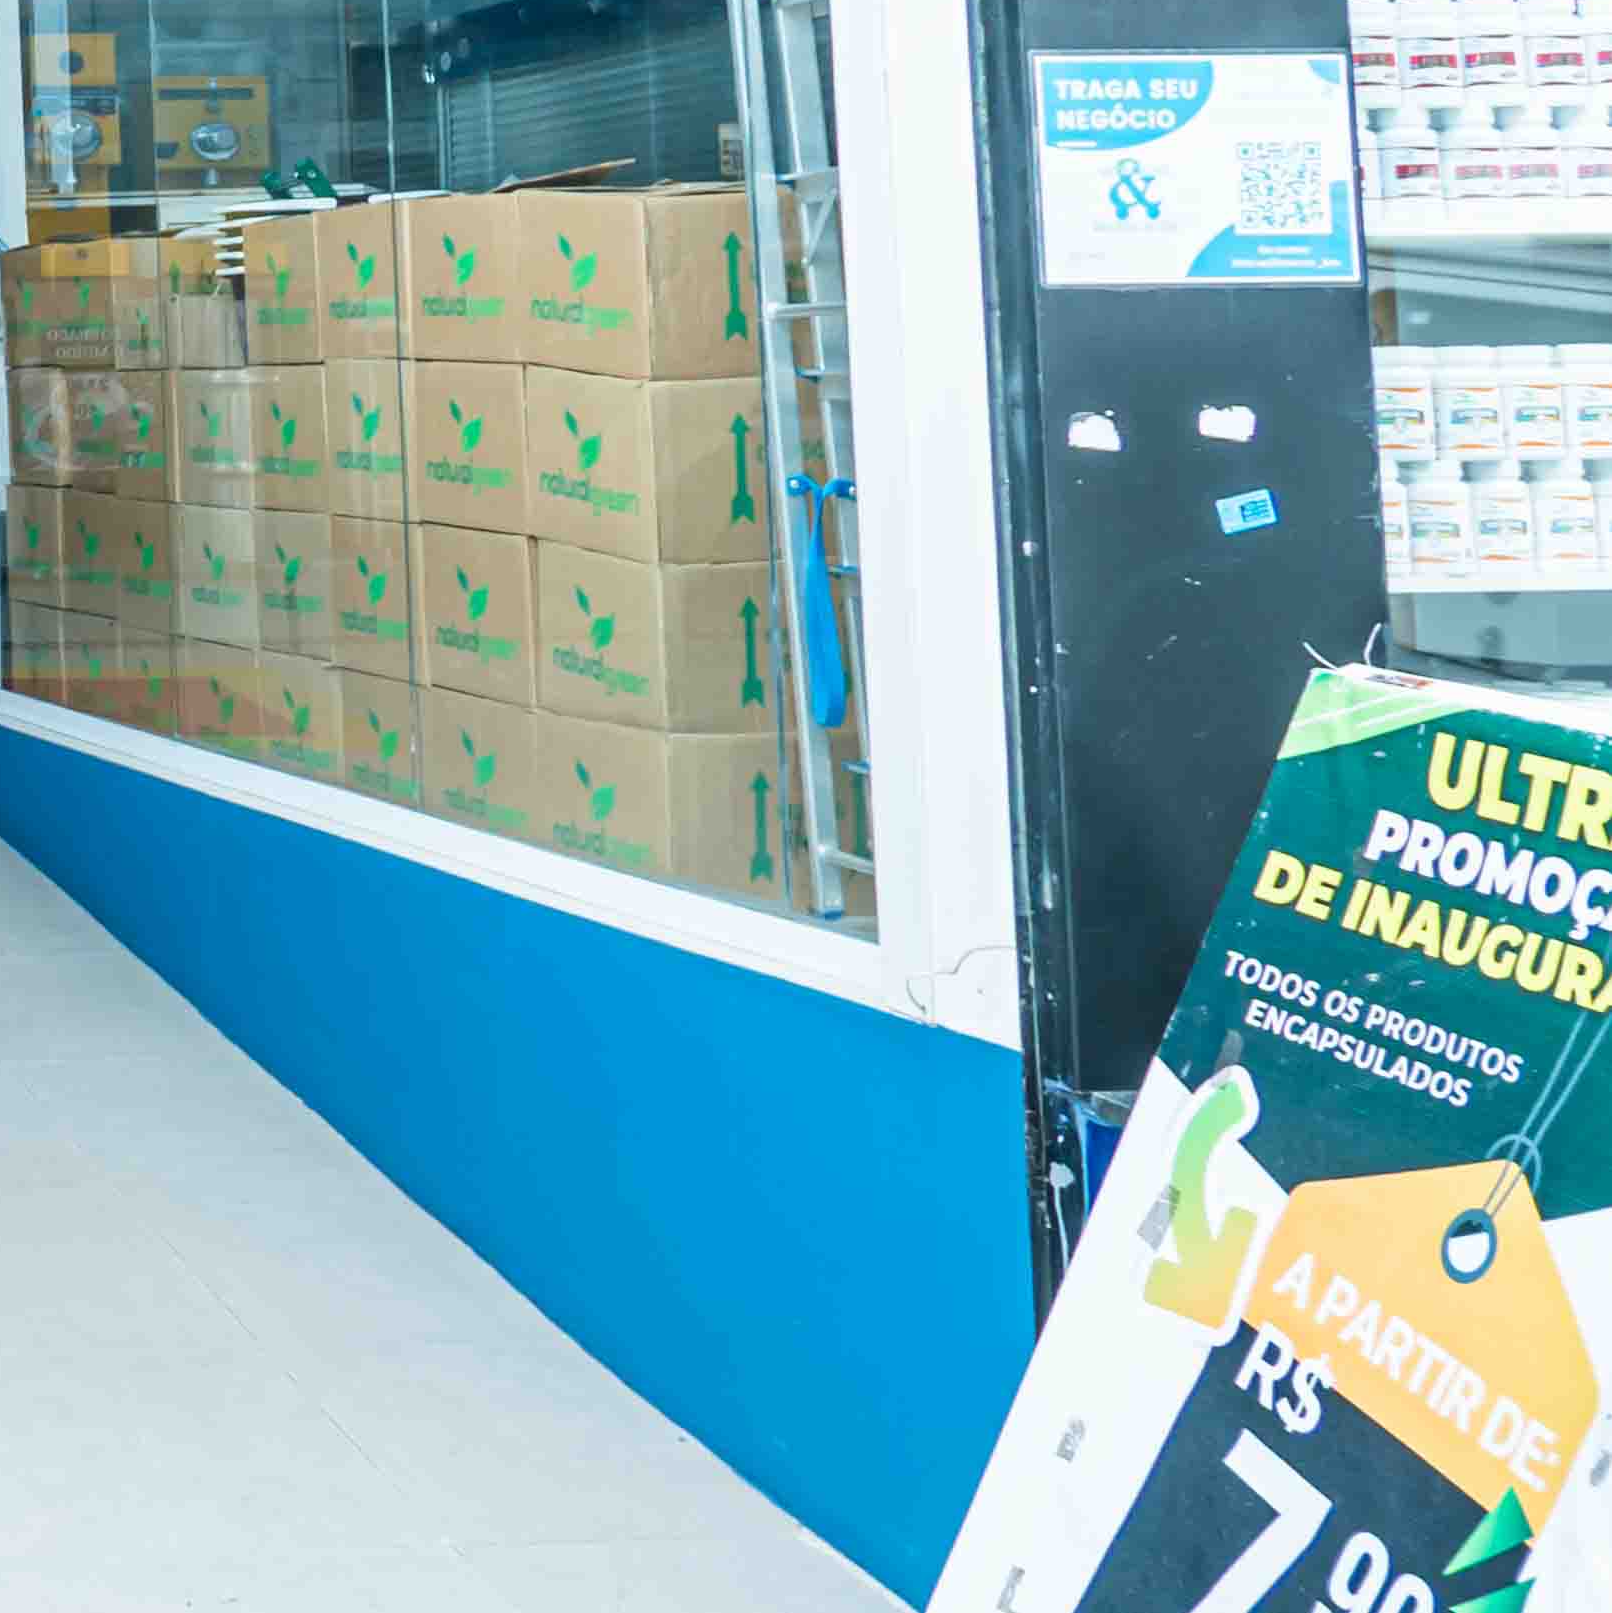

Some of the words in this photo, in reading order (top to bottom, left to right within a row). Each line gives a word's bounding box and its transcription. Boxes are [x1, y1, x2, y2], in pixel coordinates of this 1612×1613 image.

[1054, 77, 1143, 101] TRAGA
[1148, 77, 1199, 101] SEU
[1056, 102, 1178, 131] NEGÓCIO
[1426, 730, 1612, 854] ULTR
[1253, 848, 1344, 923] DE
[1363, 808, 1612, 941] PROMOÇ
[1225, 949, 1322, 1009] TODOS
[1323, 987, 1364, 1025] OS
[1364, 1003, 1525, 1084] PRODUTOS
[1244, 997, 1474, 1108] ENCAPSULADOS
[1234, 1319, 1338, 1436] R$
[1272, 1251, 1315, 1312] A
[1313, 1272, 1487, 1436] PARTIR
